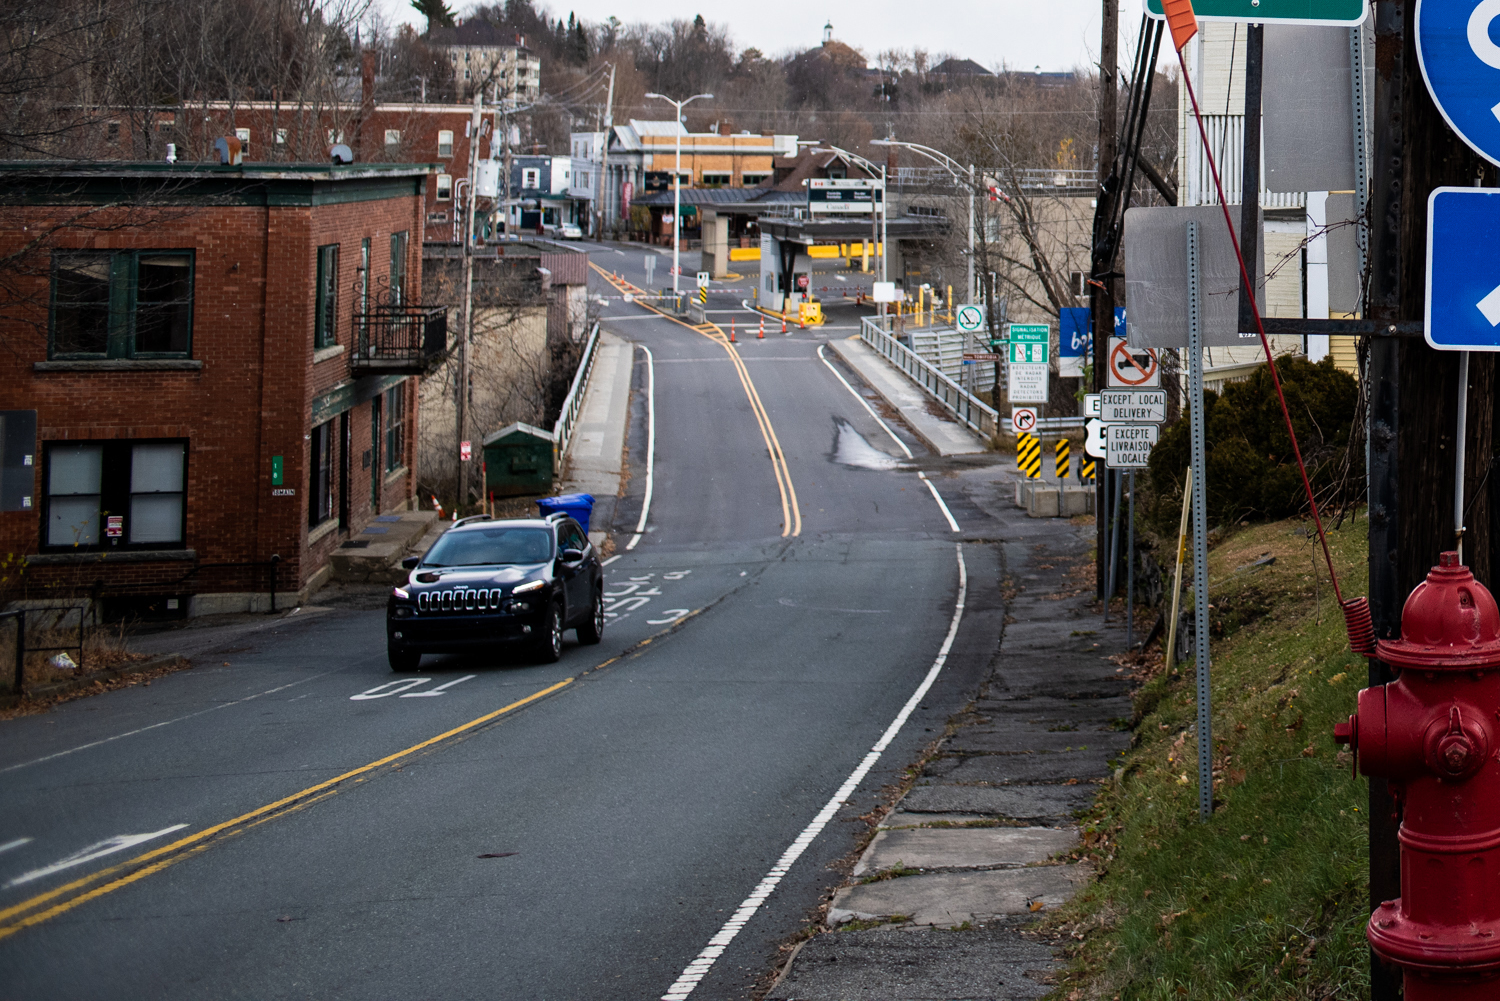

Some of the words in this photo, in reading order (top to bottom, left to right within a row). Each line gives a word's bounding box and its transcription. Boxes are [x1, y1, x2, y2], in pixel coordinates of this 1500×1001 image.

[1033, 348, 1042, 356] 50
[1139, 395, 1164, 405] LOCAL
[1113, 408, 1152, 418] DELIVERY
[1115, 429, 1150, 439] EXCEPTE
[1111, 441, 1154, 451] LIVRAISON
